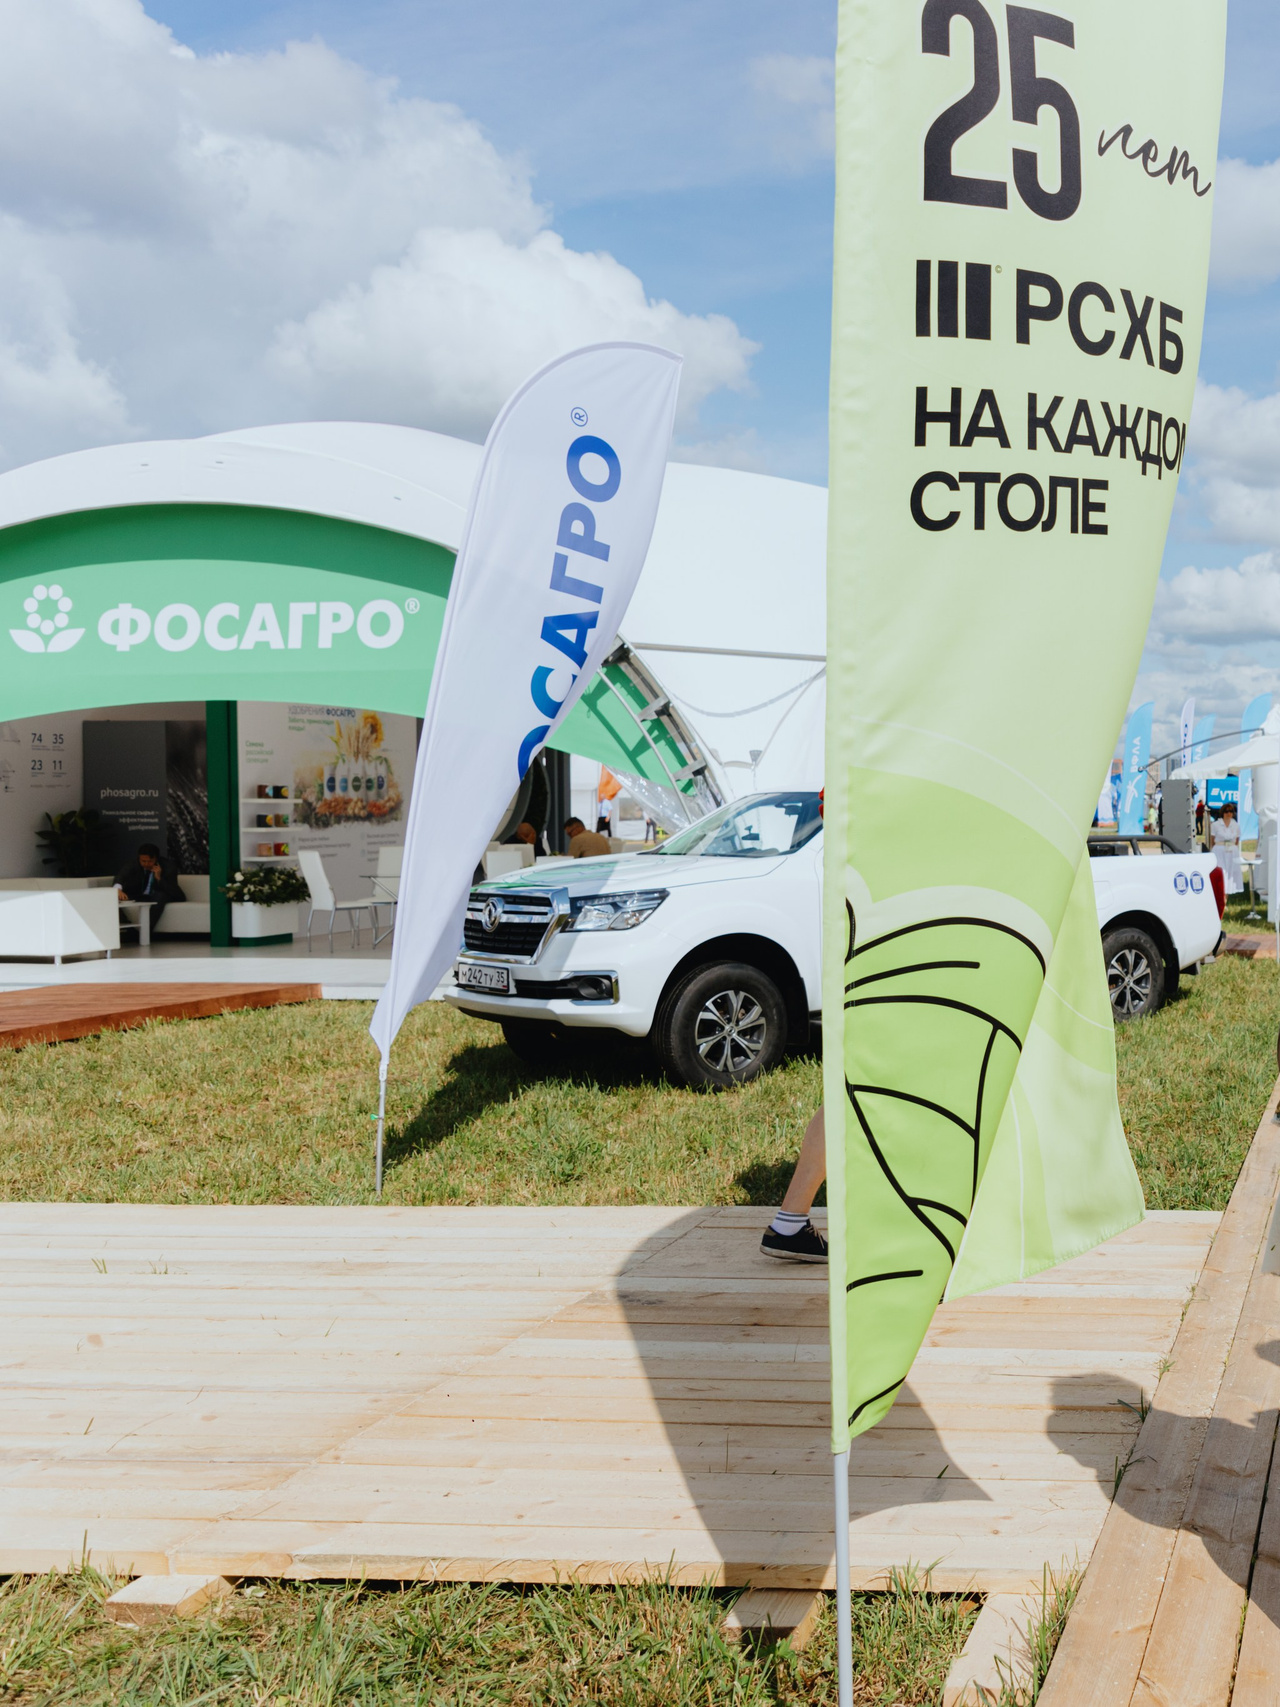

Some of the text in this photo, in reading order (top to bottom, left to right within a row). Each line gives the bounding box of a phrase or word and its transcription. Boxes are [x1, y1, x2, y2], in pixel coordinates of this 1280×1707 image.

[921, 0, 1212, 221] 25 лет
[1015, 268, 1184, 376] РСХБ
[914, 386, 1012, 449] НА
[910, 470, 1109, 536] СТОЛЕ
[326, 708, 356, 718] ФОСАГРО
[31, 733, 64, 745] 74 35
[31, 760, 63, 771] 23 11
[100, 787, 159, 799] phosagro.ru
[462, 968, 505, 986] М242ТУ 35
